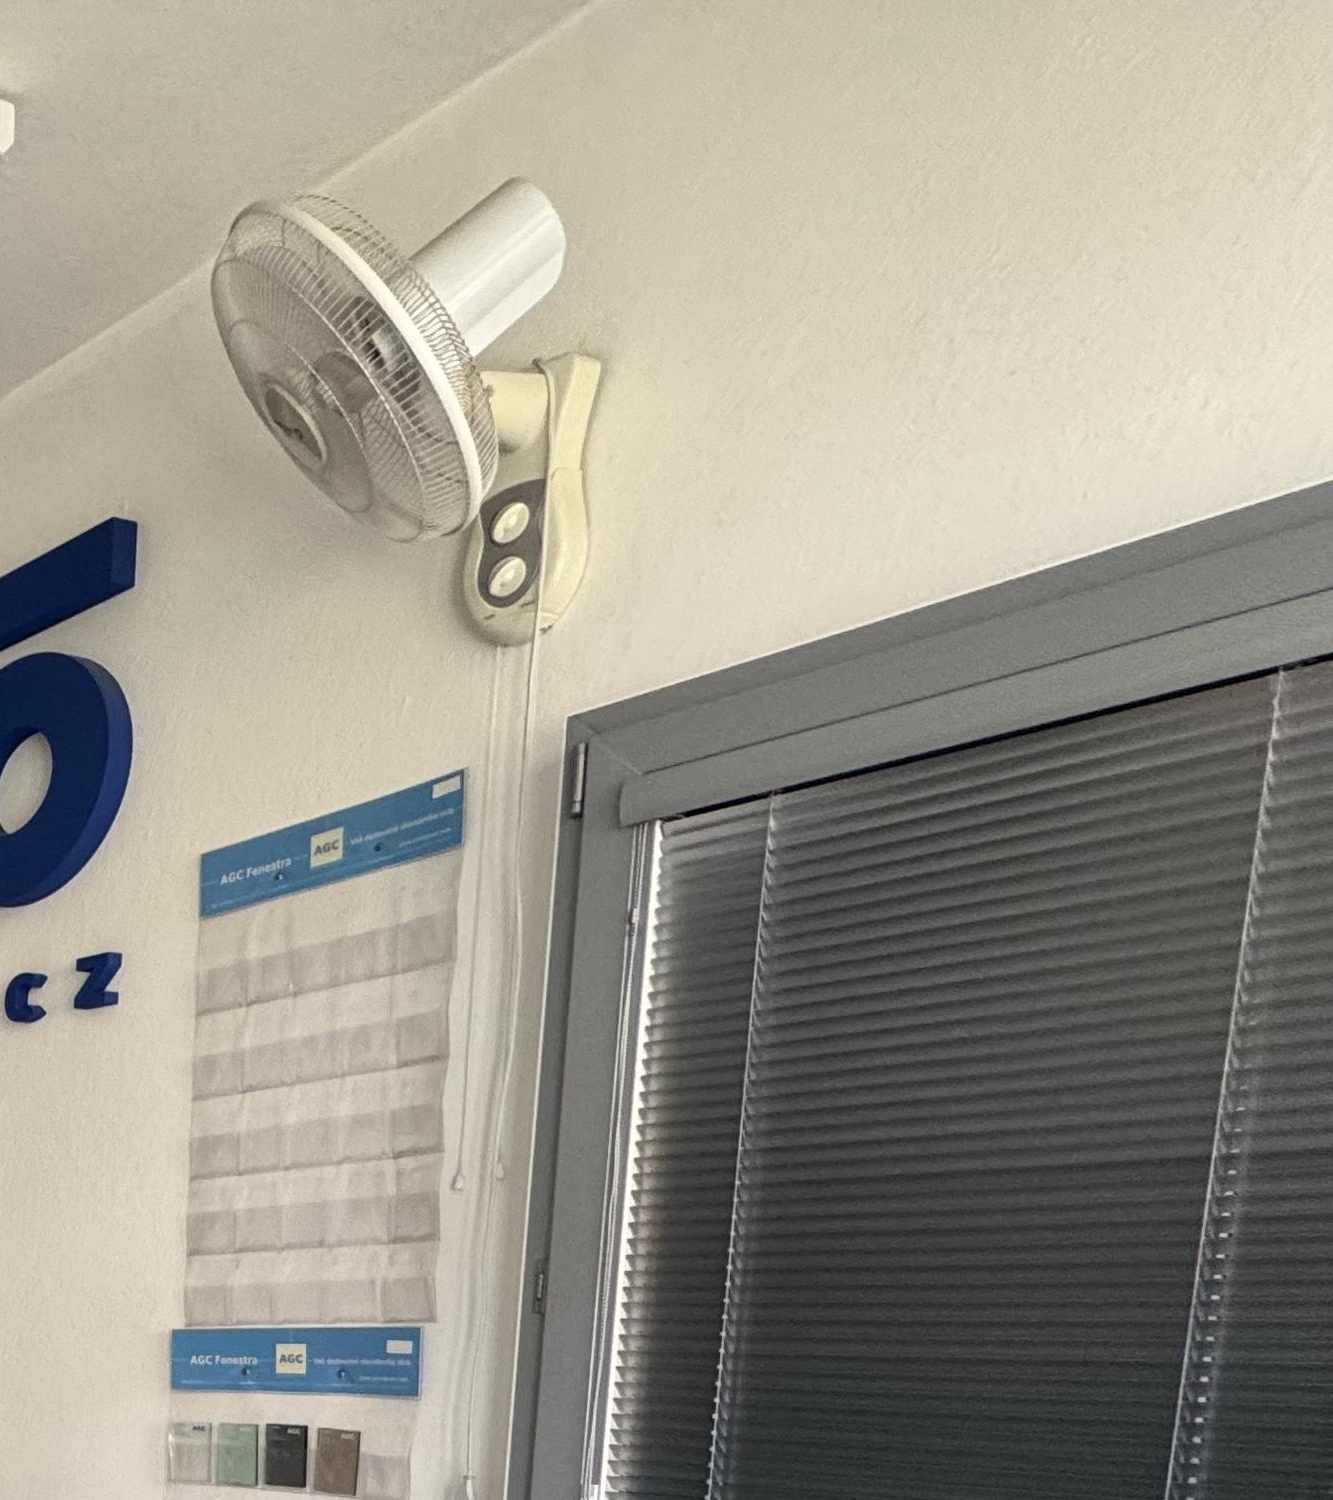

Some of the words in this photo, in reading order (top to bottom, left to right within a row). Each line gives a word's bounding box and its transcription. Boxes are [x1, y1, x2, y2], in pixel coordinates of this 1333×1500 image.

[313, 839, 340, 856] AGC
[221, 869, 245, 885] AGC
[246, 857, 292, 879] Fenestra
[190, 1354, 213, 1366] AGC
[279, 1354, 304, 1364] AGC
